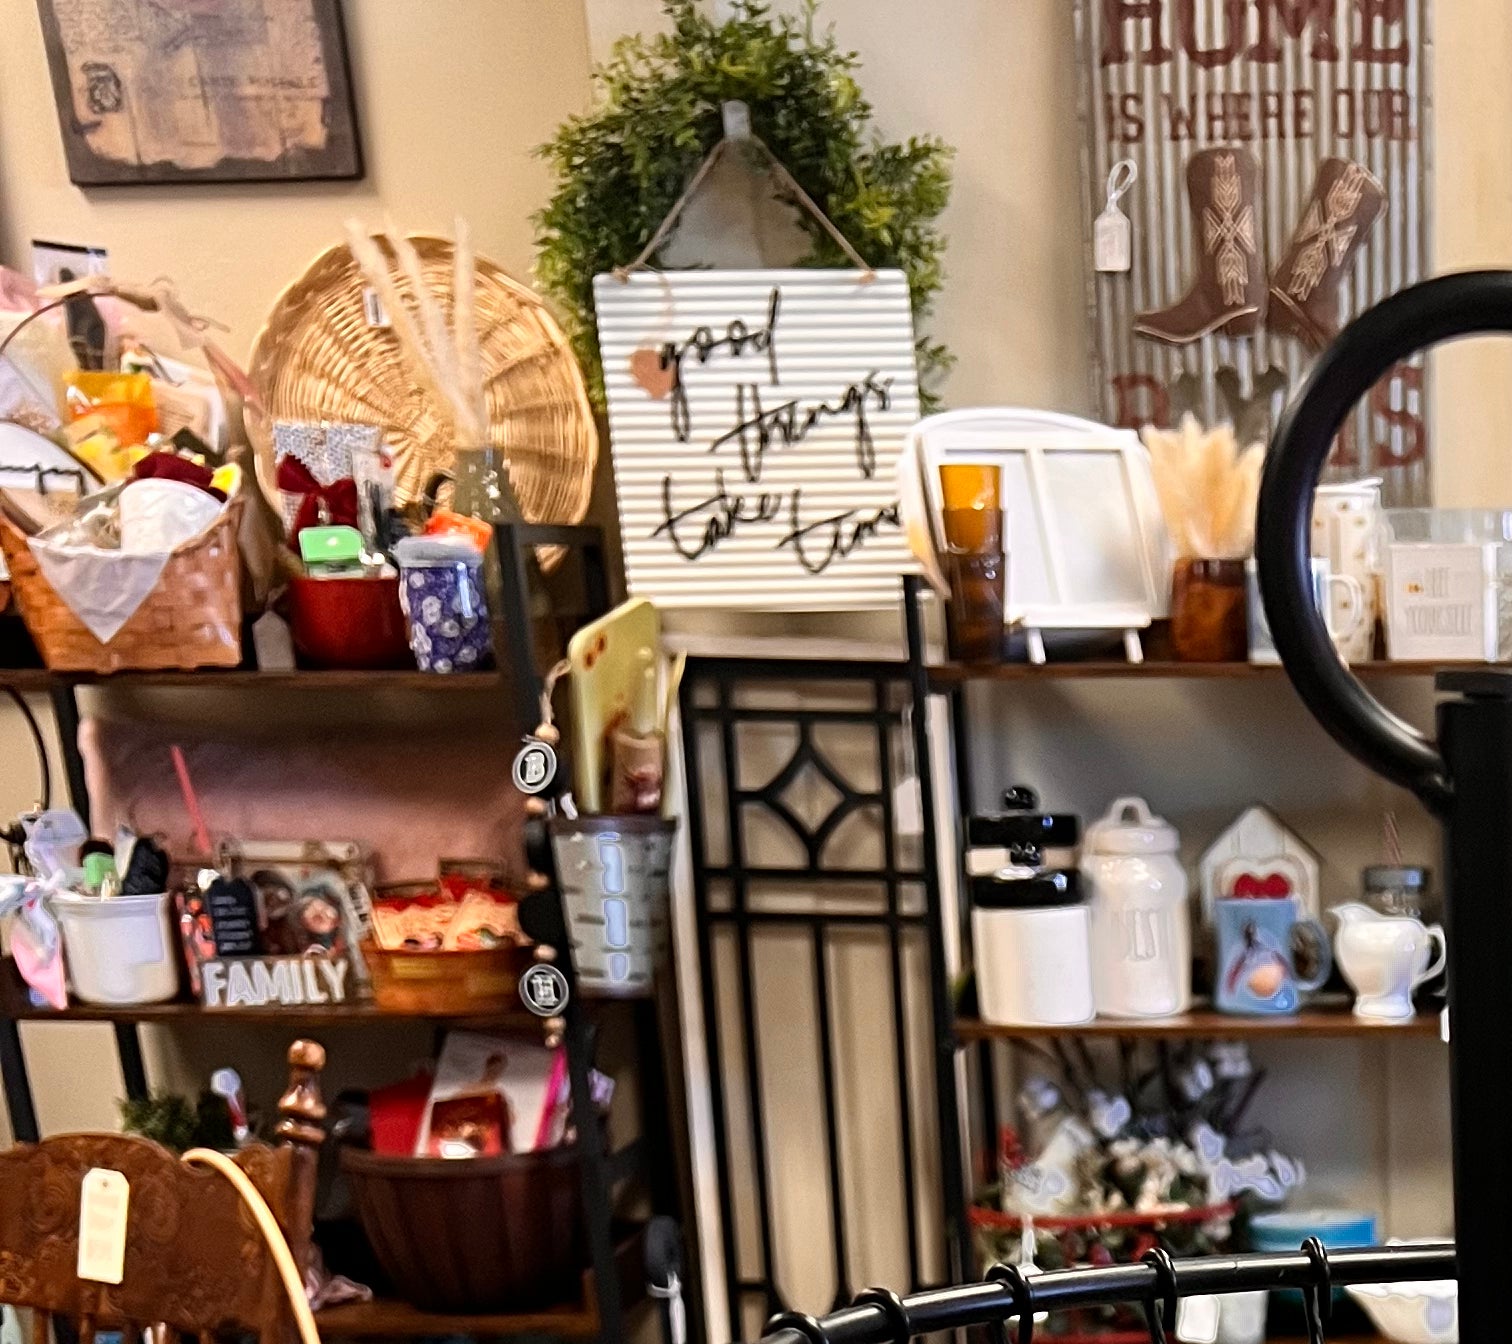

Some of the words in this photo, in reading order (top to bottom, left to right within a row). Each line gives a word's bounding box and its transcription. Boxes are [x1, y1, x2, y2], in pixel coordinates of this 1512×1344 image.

[1106, 94, 1144, 143] IS
[1160, 88, 1314, 142] WHERE
[1335, 88, 1417, 141] OUR
[658, 283, 783, 443] good
[706, 367, 895, 483] things
[649, 467, 783, 561] take
[203, 958, 349, 1008] FAMILY
